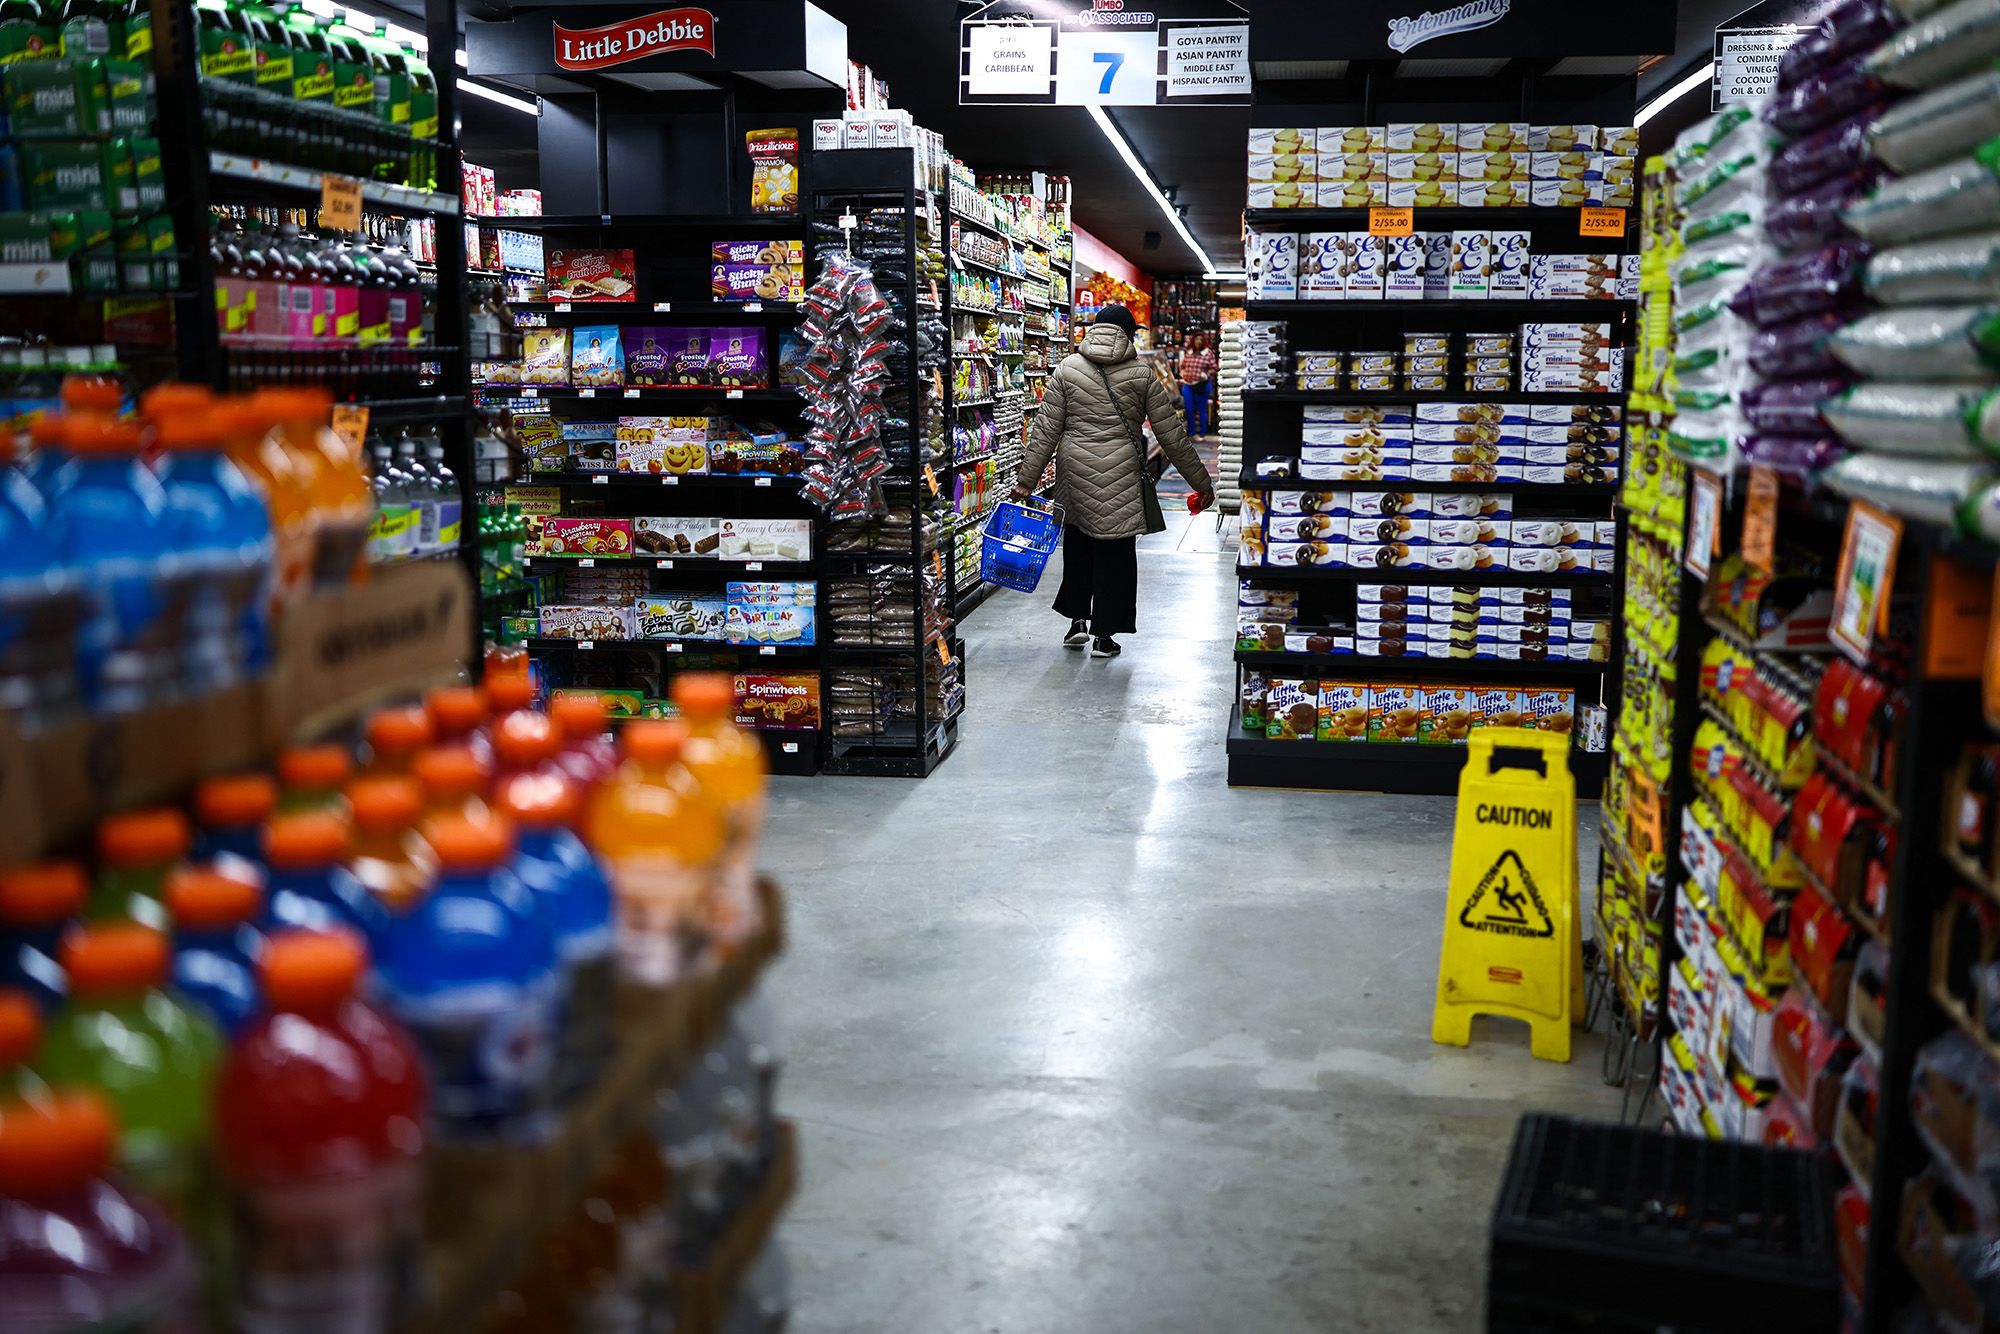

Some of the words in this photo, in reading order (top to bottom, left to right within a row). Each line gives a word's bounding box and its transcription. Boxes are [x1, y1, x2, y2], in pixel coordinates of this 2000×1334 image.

[1092, 0, 1123, 11] JUMBO
[1093, 13, 1153, 23] ASSOCIATED
[1389, 0, 1509, 47] Entenmanns
[563, 35, 622, 62] Little
[626, 18, 704, 52] Debbie
[1177, 37, 1203, 46] GOYA
[1206, 35, 1242, 45] PANTRY
[1727, 44, 1766, 52] DRESSING
[993, 51, 1026, 59] GRAINS
[1176, 51, 1204, 60] ASIAN
[1206, 50, 1243, 59] PANTRY
[1737, 55, 1785, 63] CONDIMEN
[985, 65, 1034, 73] CARIBBEAN
[1093, 53, 1125, 94] 7
[1746, 65, 1779, 73] VINEGA
[1173, 77, 1210, 85] HISPANIC
[1213, 76, 1245, 84] PANTRY
[1736, 76, 1777, 84] COCONUT
[35, 84, 75, 110] mini
[1731, 87, 1745, 95] OIL
[1746, 87, 1754, 95] &
[114, 106, 146, 126] mini
[57, 163, 100, 187] mini
[1374, 219, 1408, 228] 2/$5.00
[1585, 218, 1620, 228] 2/$5.00
[3, 239, 50, 260] mini
[729, 244, 758, 255] Sticky
[572, 256, 605, 269] Cherry
[731, 252, 757, 262] Buns
[567, 267, 590, 280] Fruit
[590, 264, 611, 275] Pies
[728, 269, 764, 282] Sticky
[730, 279, 761, 290] Buns
[541, 438, 563, 449] Bars
[736, 449, 780, 460] Brownies
[579, 461, 600, 469] WISS
[603, 461, 617, 469] RO
[560, 522, 601, 538] Strawberry
[650, 519, 682, 531] Frosted
[683, 520, 707, 531] Fudge
[738, 522, 767, 535] Fancy
[768, 522, 796, 534] Cakes
[748, 584, 780, 593] BIRTHDAY
[748, 596, 780, 605] BIRTHDAY
[553, 612, 610, 627] Gingerbread
[638, 614, 673, 628] Zebra
[744, 611, 792, 624] BIRTHDAY
[644, 624, 672, 635] Cakes
[749, 684, 807, 696] Spinwheels
[1273, 683, 1297, 700] Little
[1280, 693, 1305, 708] Bites
[1324, 688, 1349, 706] Little
[1375, 689, 1400, 707] Little
[1427, 691, 1451, 709] Little
[1478, 692, 1503, 710] Little
[1529, 693, 1554, 711] Little
[1332, 697, 1357, 713] Bites
[1383, 698, 1408, 714] Bites
[1434, 701, 1460, 716] Bites
[1485, 702, 1511, 717] Bites
[1536, 703, 1563, 718] Bites
[1476, 803, 1552, 829] CAUTION
[1467, 864, 1500, 908] CAUTION
[1474, 923, 1538, 938] ATTENTION
